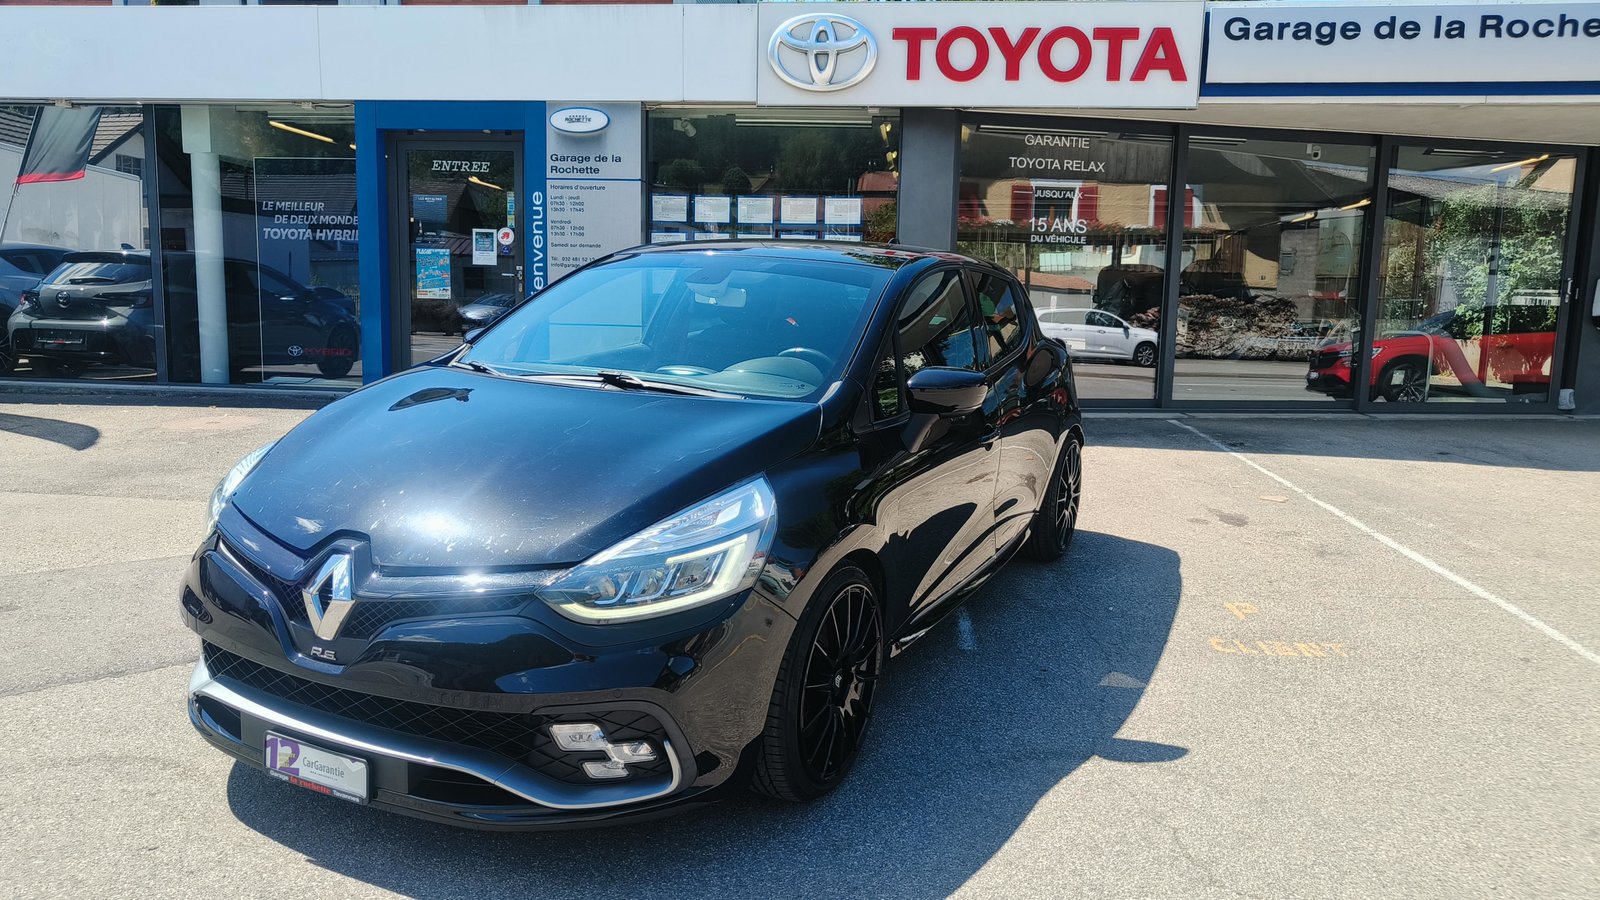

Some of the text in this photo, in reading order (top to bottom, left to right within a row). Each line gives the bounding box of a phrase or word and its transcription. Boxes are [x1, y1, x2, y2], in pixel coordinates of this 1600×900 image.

[1224, 13, 1600, 46] Garage de la Roche
[892, 26, 1187, 82] TOYOTA
[1024, 134, 1090, 149] GARANTIE
[550, 154, 591, 164] Garage
[594, 154, 608, 162] de
[1008, 156, 1106, 172] TOYOTA RELAX
[431, 160, 490, 172] ENTREE
[550, 166, 600, 174] Rochette
[1034, 190, 1083, 199] JUSQU'AUX
[262, 201, 324, 212] LE MEILLEUR
[274, 215, 358, 225] DE DEUX MONDE
[1029, 217, 1087, 234] 15 ANS
[263, 228, 313, 240] TOYOTA
[1030, 234, 1086, 244] DU VÉHICULE
[1223, 601, 1259, 620] P
[266, 738, 344, 778] 12 CarGarantie
